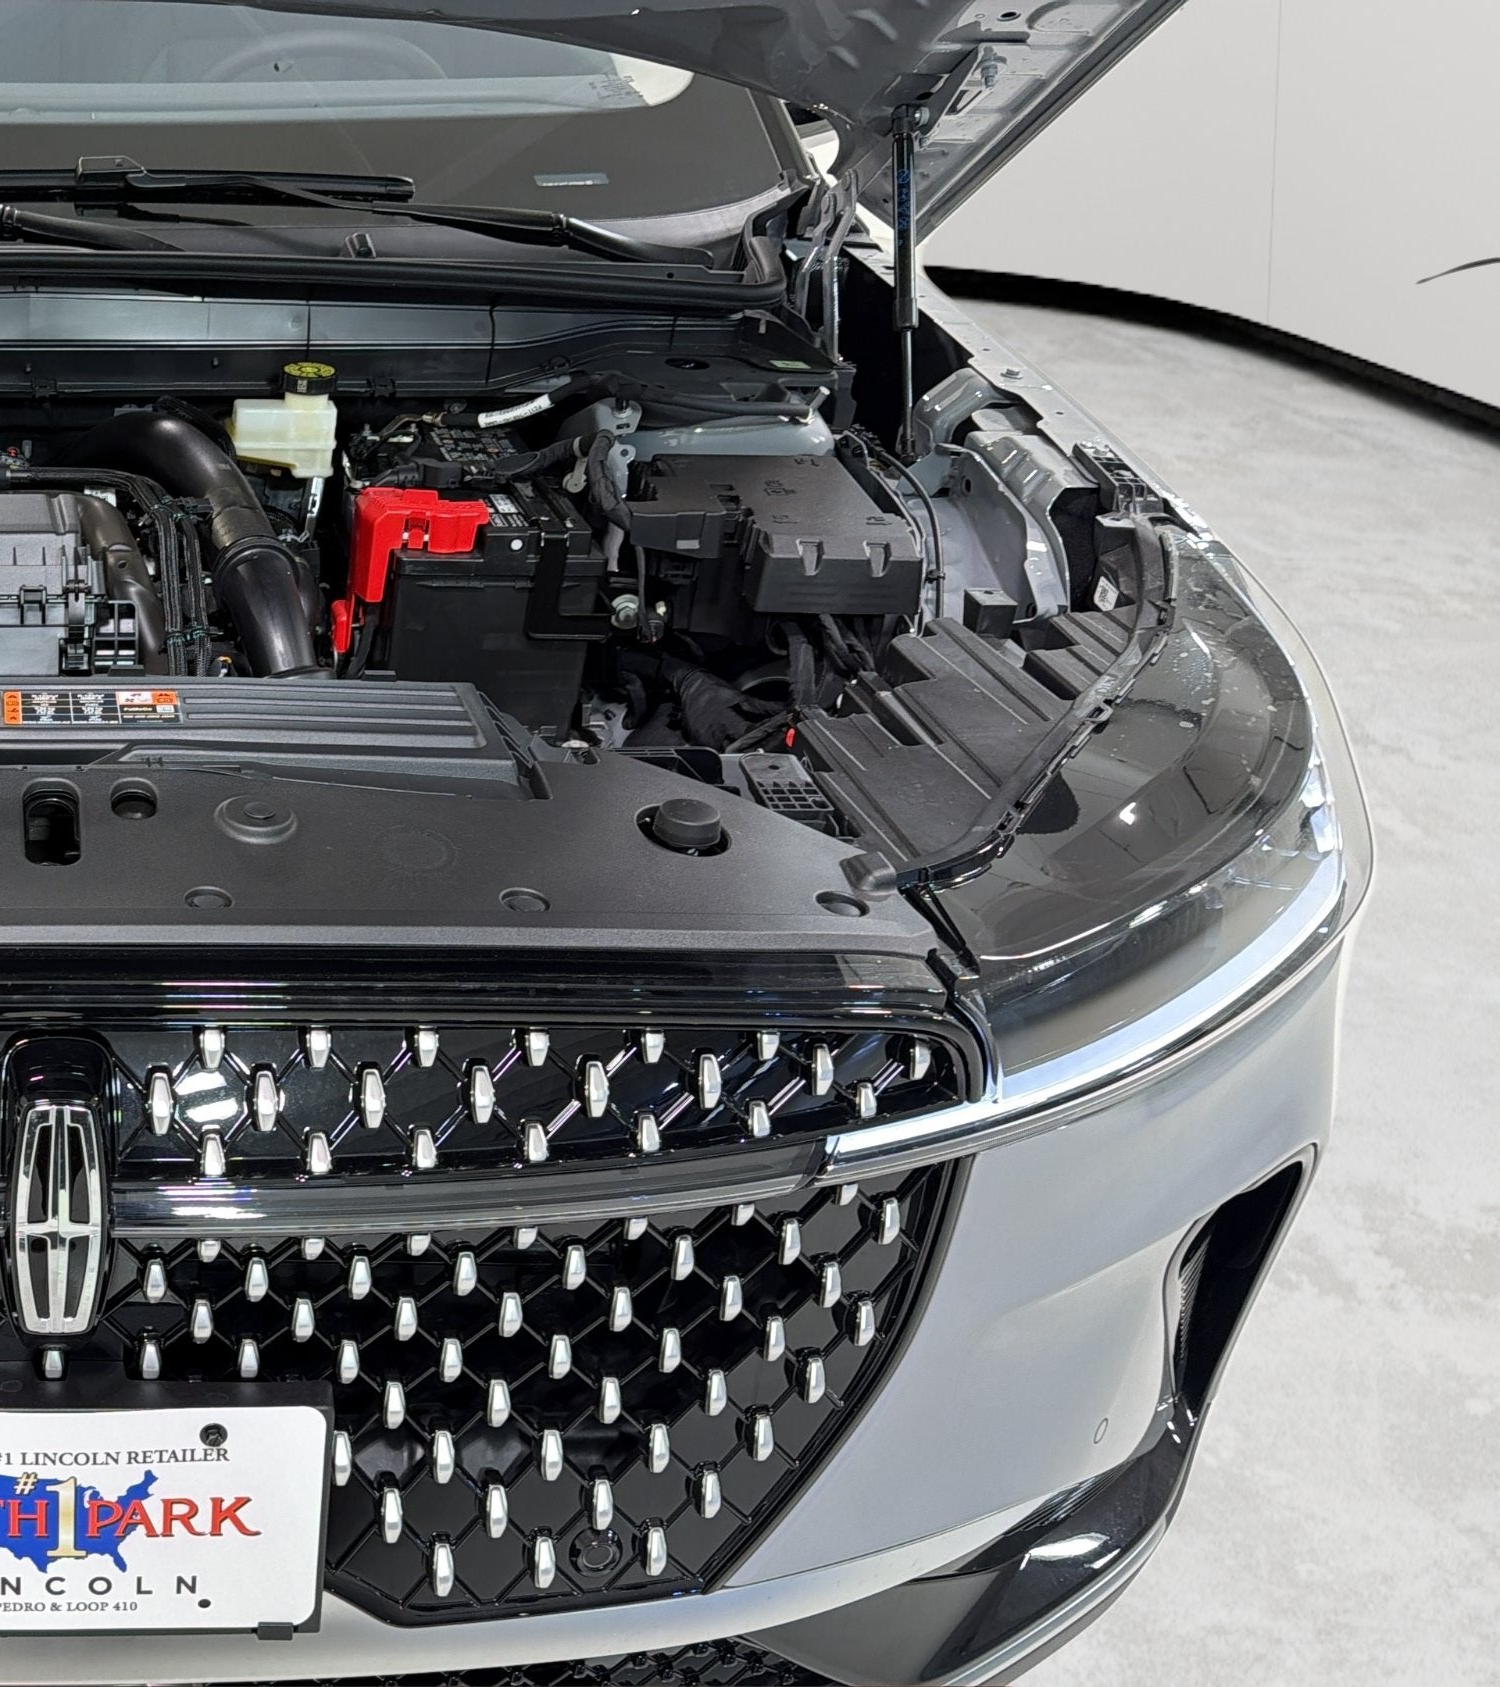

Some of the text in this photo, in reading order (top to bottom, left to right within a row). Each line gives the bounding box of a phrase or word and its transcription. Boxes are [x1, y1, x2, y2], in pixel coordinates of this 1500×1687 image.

[20, 1451, 121, 1466] LINCOLN
[126, 1447, 230, 1465] RETAILER
[87, 1497, 261, 1539] PARK
[50, 1602, 62, 1612] &
[66, 1601, 109, 1612] LOOP
[112, 1601, 138, 1611] 410
